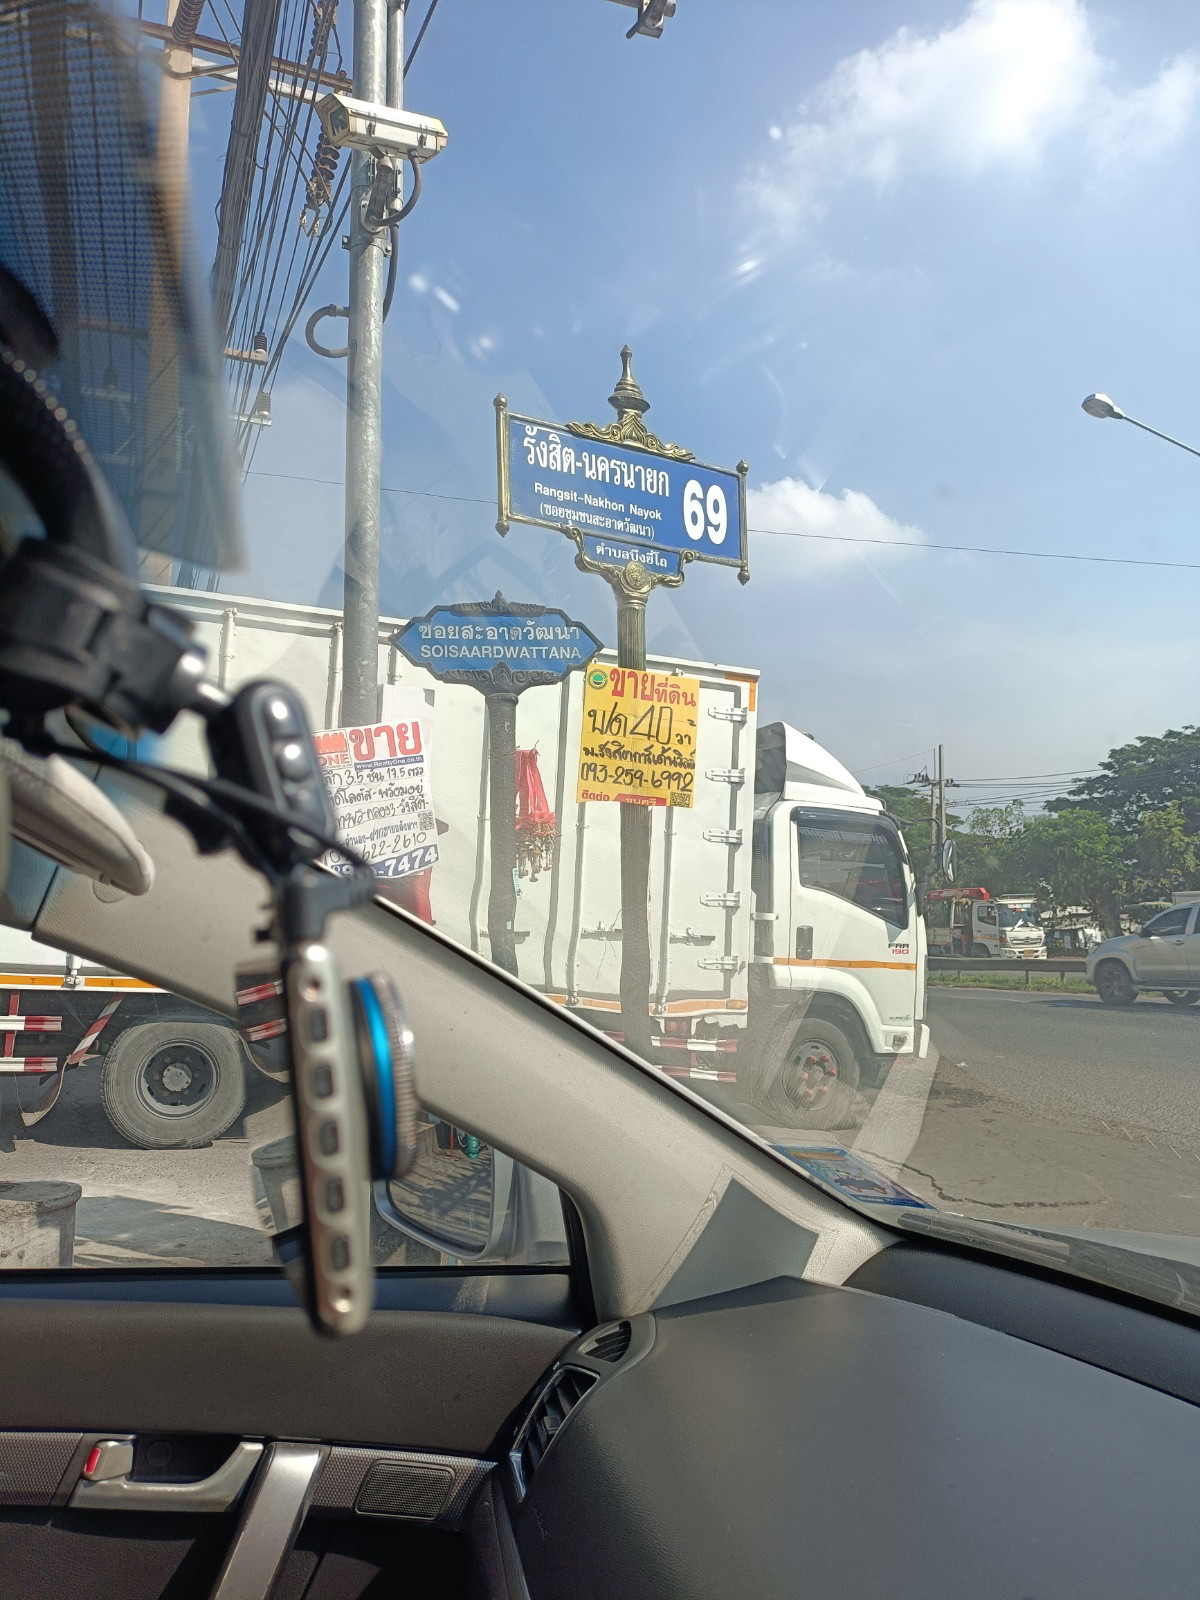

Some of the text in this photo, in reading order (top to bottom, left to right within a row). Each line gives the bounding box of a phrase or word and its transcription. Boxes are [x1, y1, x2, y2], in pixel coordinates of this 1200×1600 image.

[523, 426, 670, 497] รังสิต-นครนายก
[629, 504, 662, 521] Nayok
[683, 479, 728, 545] 69
[596, 542, 668, 568] ตำบลบึงยี่โถ
[418, 620, 581, 641] ซอยสะอาดวัฒนา
[420, 644, 582, 659] SOISAARDWATTANA
[609, 668, 697, 707] ขายที่ดิน
[629, 704, 673, 745] 40
[349, 721, 423, 762] ขาย
[344, 769, 364, 786] 3.5
[580, 762, 694, 792] 093-259-6992
